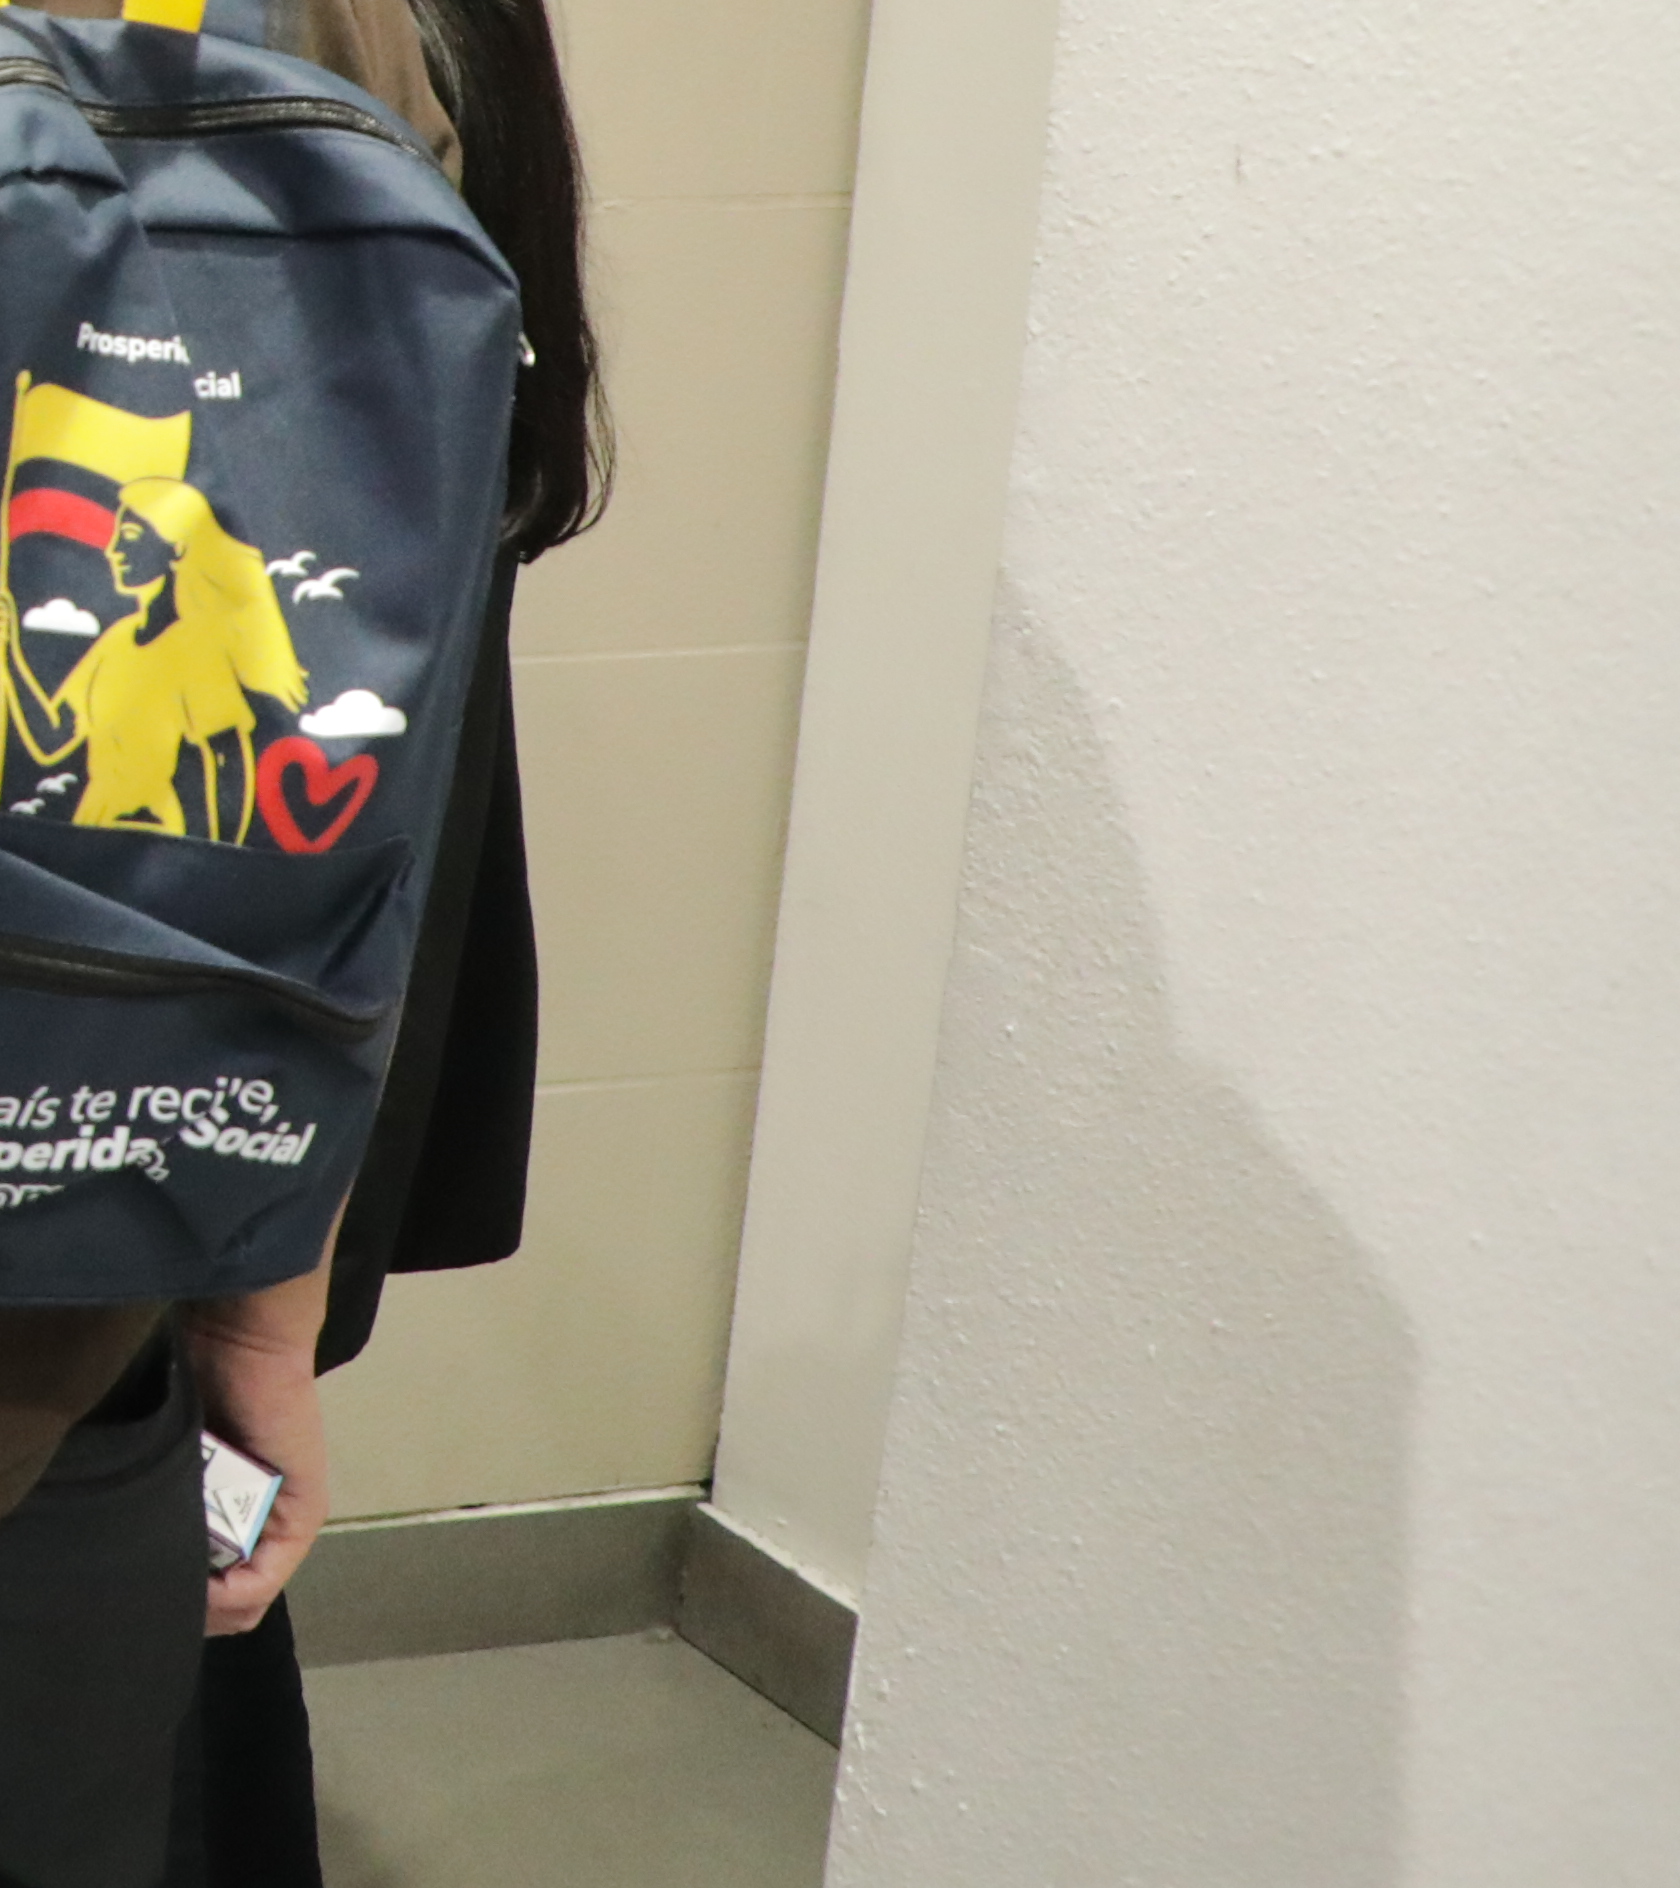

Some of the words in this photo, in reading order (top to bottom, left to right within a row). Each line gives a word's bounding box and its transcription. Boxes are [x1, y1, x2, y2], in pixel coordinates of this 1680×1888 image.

[77, 322, 191, 366] Prosperi
[194, 370, 242, 399] cial
[70, 1085, 117, 1123] te
[179, 1115, 317, 1165] Social
